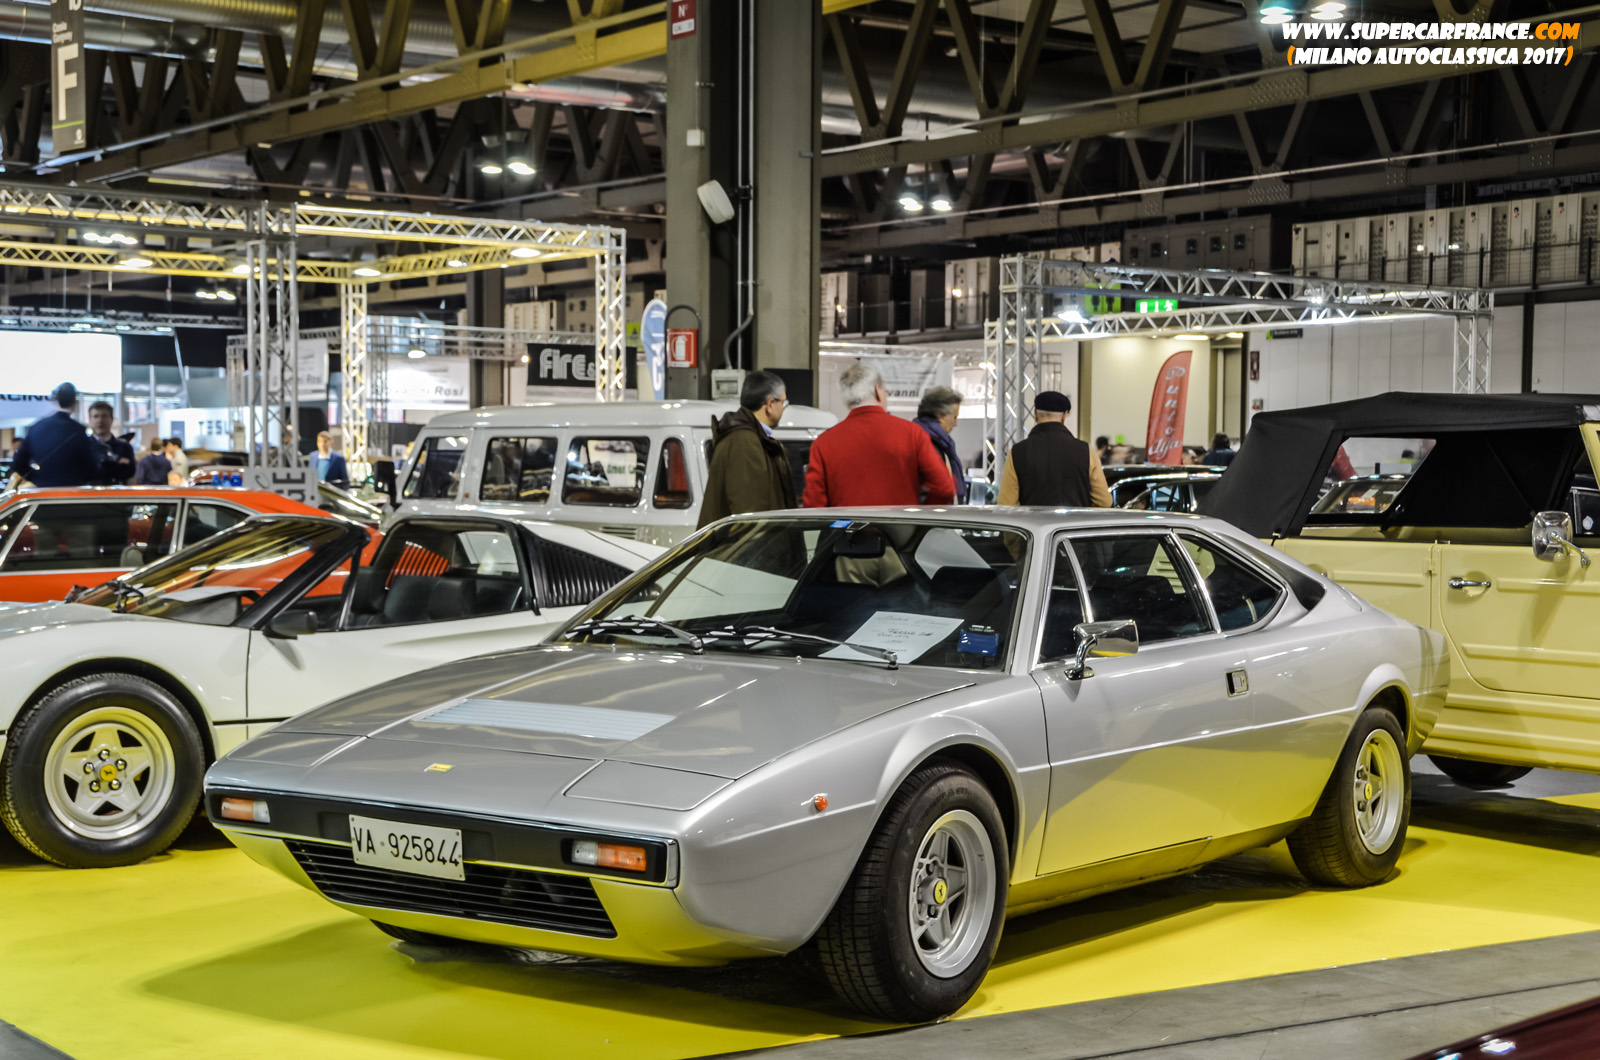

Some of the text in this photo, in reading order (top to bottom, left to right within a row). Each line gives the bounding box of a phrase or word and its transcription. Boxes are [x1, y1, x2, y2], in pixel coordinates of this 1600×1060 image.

[57, 43, 79, 121] F
[353, 826, 460, 867] VA 925844
